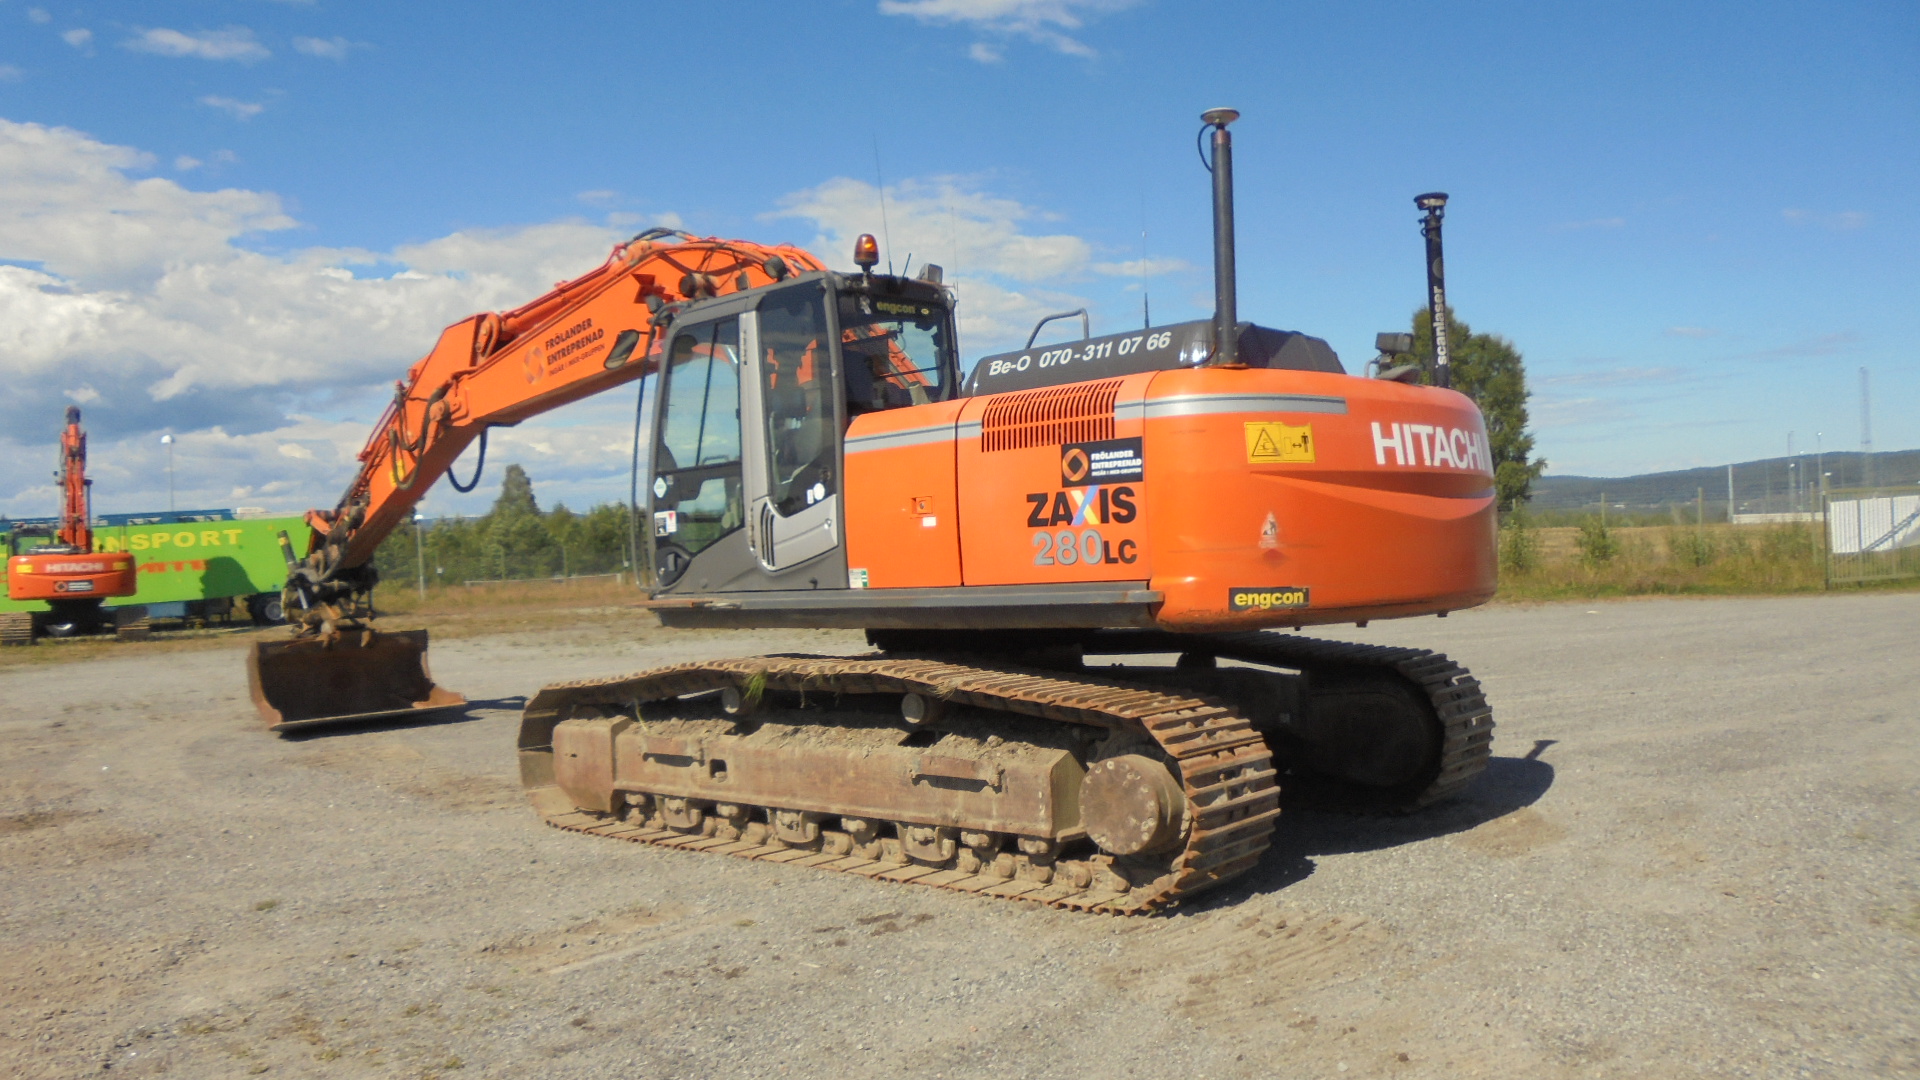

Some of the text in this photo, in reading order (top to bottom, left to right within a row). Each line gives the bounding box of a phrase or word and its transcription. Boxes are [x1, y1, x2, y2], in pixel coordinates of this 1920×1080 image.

[545, 318, 592, 350] FRÖLANDER
[1118, 336, 1143, 355] 07
[1146, 331, 1172, 350] 66
[1433, 285, 1448, 365] scanlaser
[547, 328, 604, 365] ENTREPRENAD
[1371, 422, 1486, 470] HITACHI
[1026, 485, 1137, 527] ZAXIS
[1234, 591, 1304, 609] engcon
